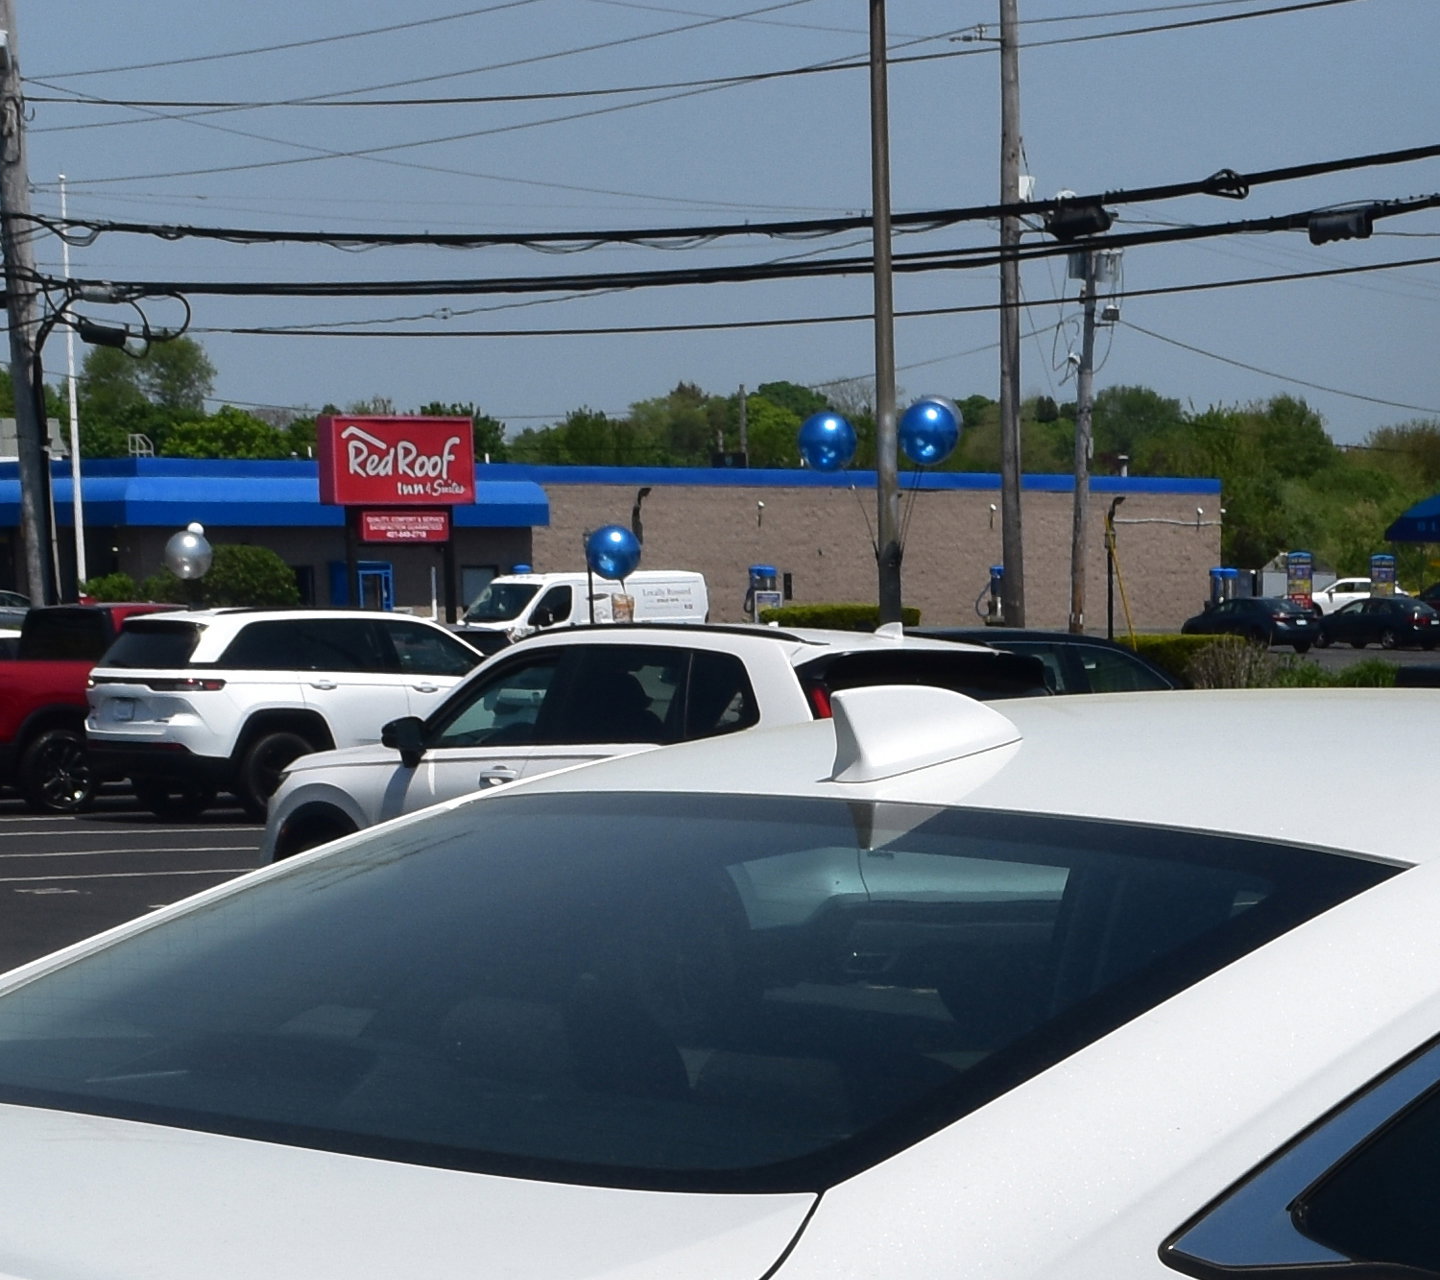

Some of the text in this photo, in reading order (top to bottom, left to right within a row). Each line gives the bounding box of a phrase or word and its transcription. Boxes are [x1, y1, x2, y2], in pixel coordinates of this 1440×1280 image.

[348, 437, 460, 480] Red Roof
[397, 482, 423, 495] Inn
